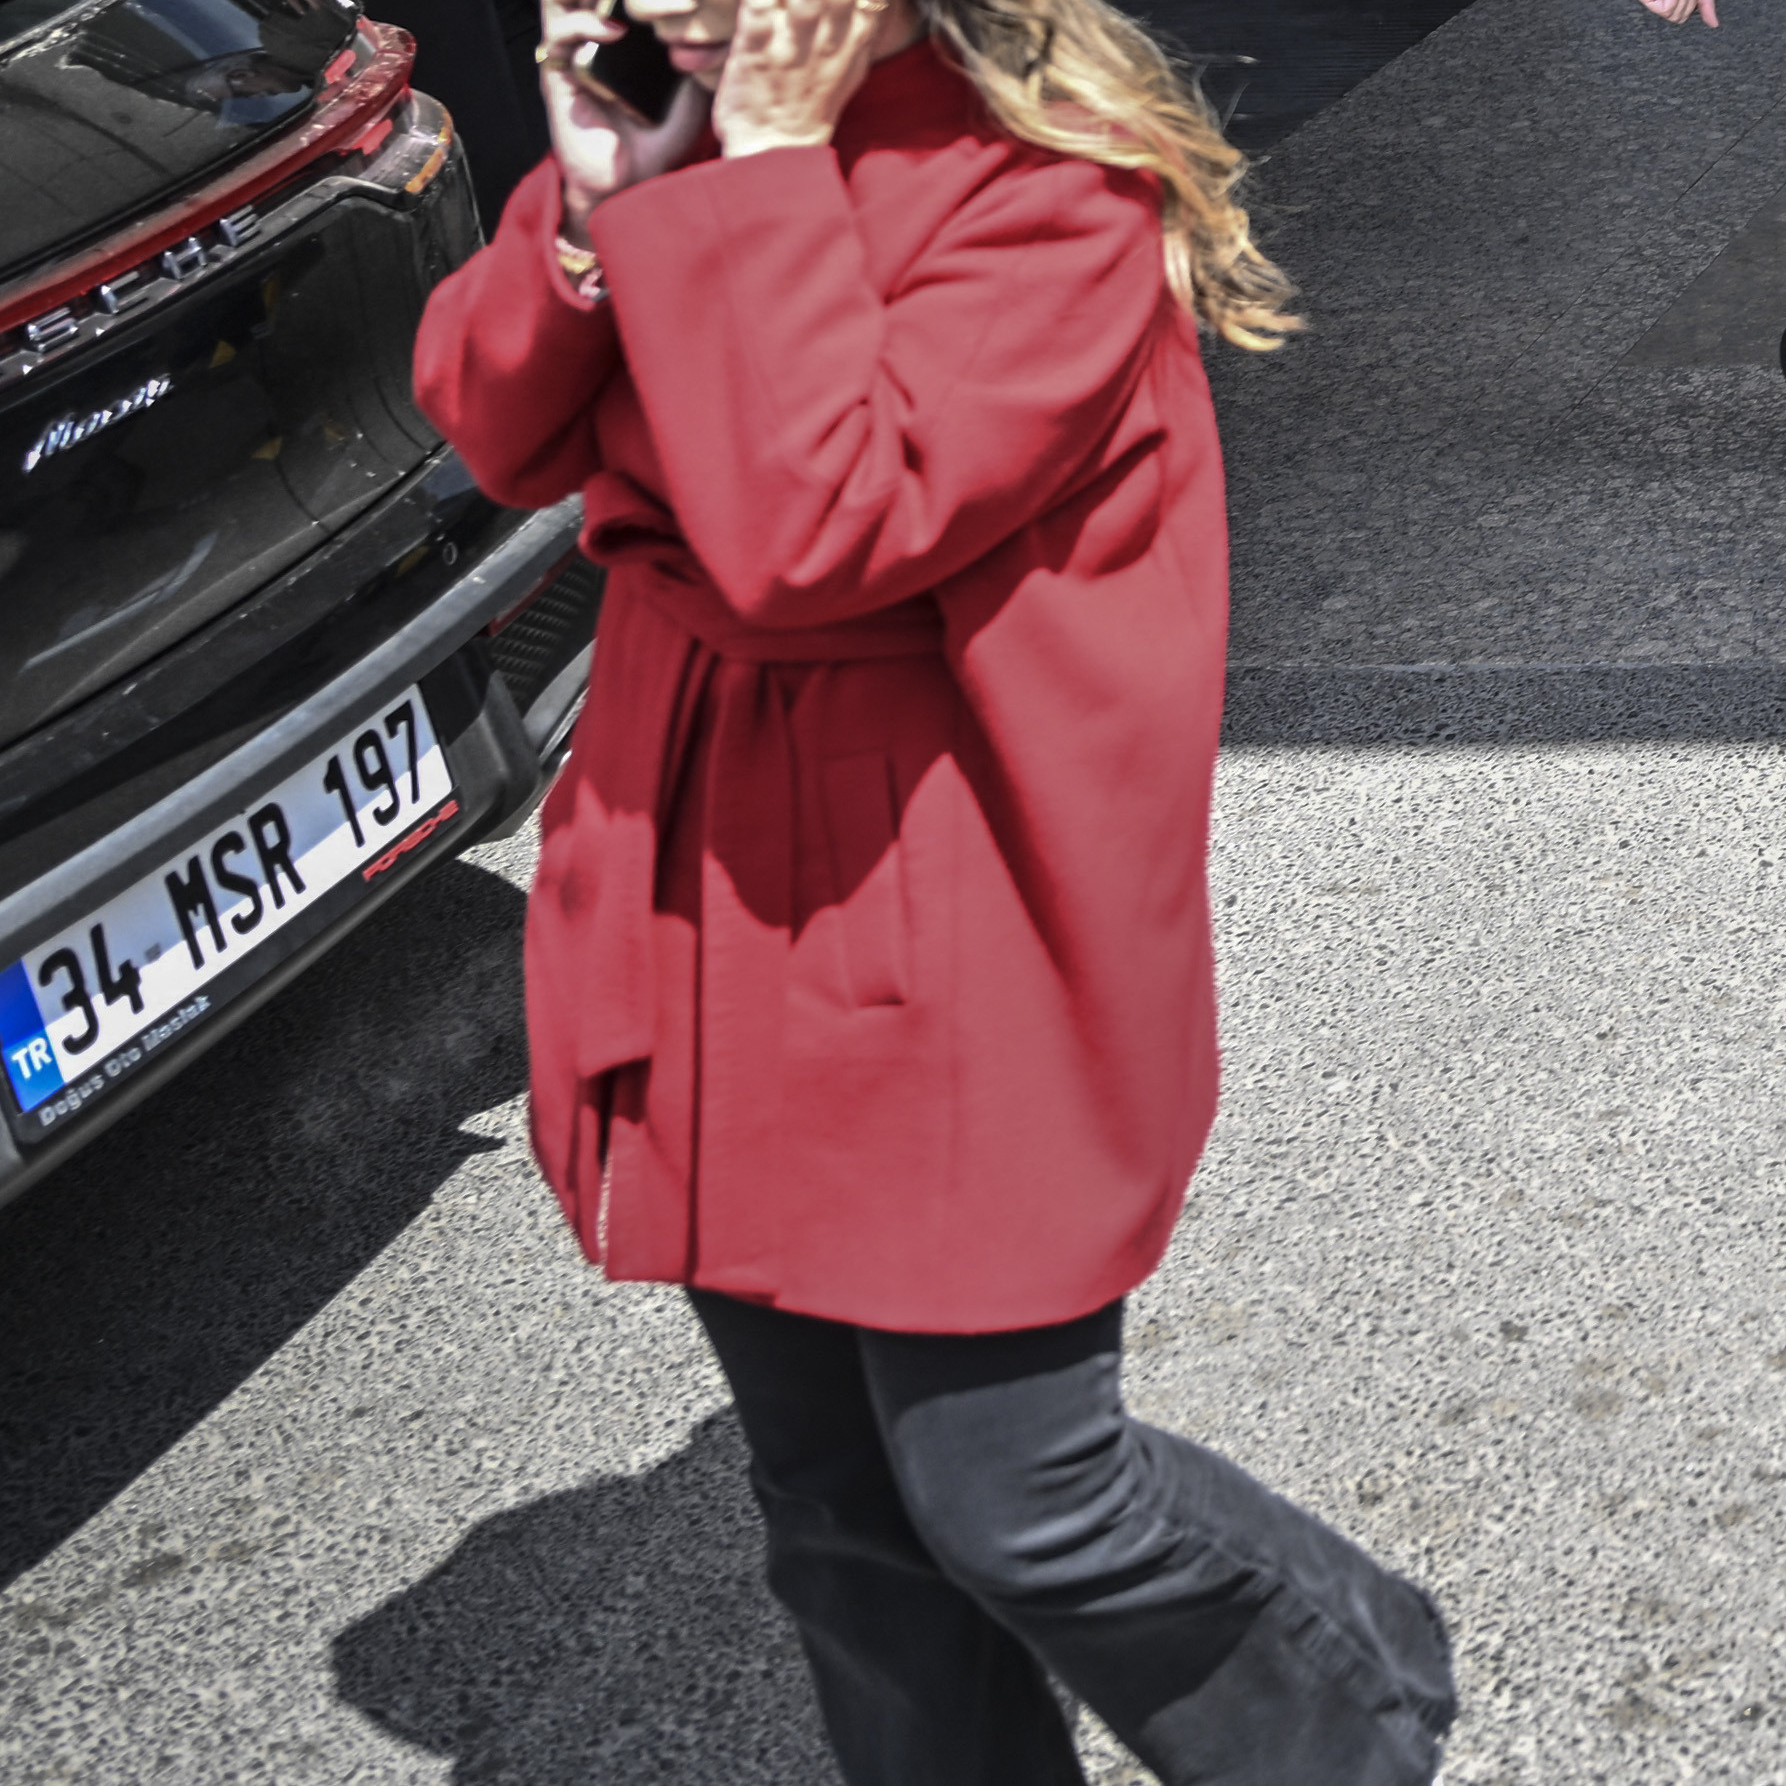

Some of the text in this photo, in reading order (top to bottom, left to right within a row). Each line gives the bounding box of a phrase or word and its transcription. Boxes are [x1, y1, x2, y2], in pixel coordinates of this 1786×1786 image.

[362, 799, 458, 882] PORSCHE
[38, 699, 420, 1056] 34 MSR 197
[11, 1037, 52, 1079] TR
[105, 1047, 142, 1077] Oto
